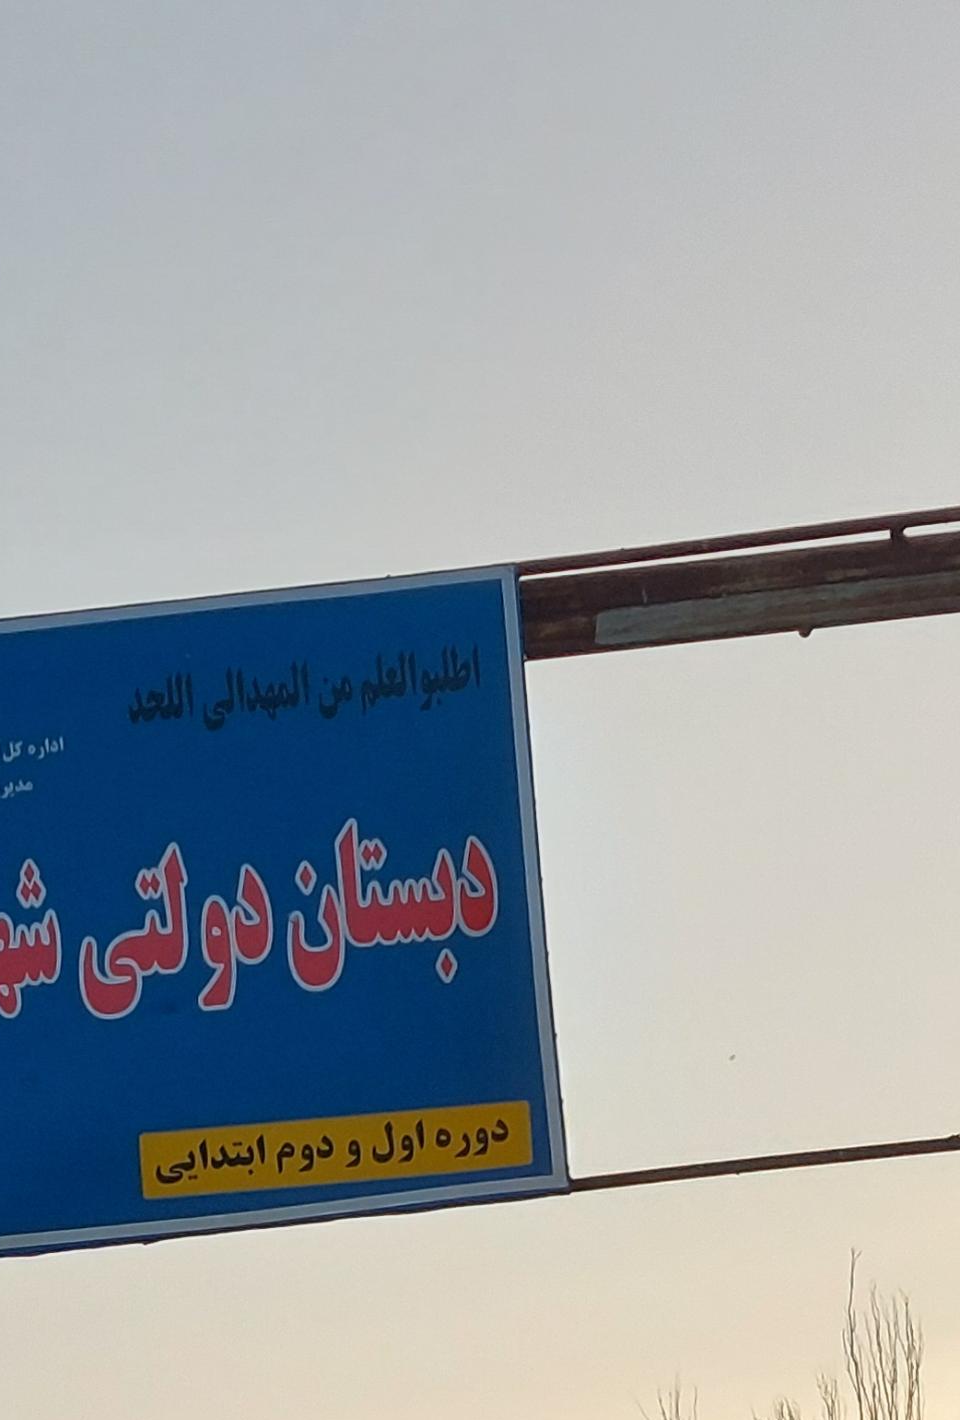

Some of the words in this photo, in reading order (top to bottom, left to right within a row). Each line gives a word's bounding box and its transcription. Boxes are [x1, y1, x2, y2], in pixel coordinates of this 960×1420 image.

[319, 675, 353, 719] من
[3, 741, 23, 762] کل
[28, 737, 64, 759] اداره
[287, 818, 499, 992] دبستان
[78, 842, 274, 1020] دولتی
[155, 1135, 266, 1181] ابتدایی
[276, 1133, 335, 1175] دوم
[345, 1138, 362, 1169] و
[371, 1120, 425, 1164] اول
[435, 1118, 510, 1159] دوره
